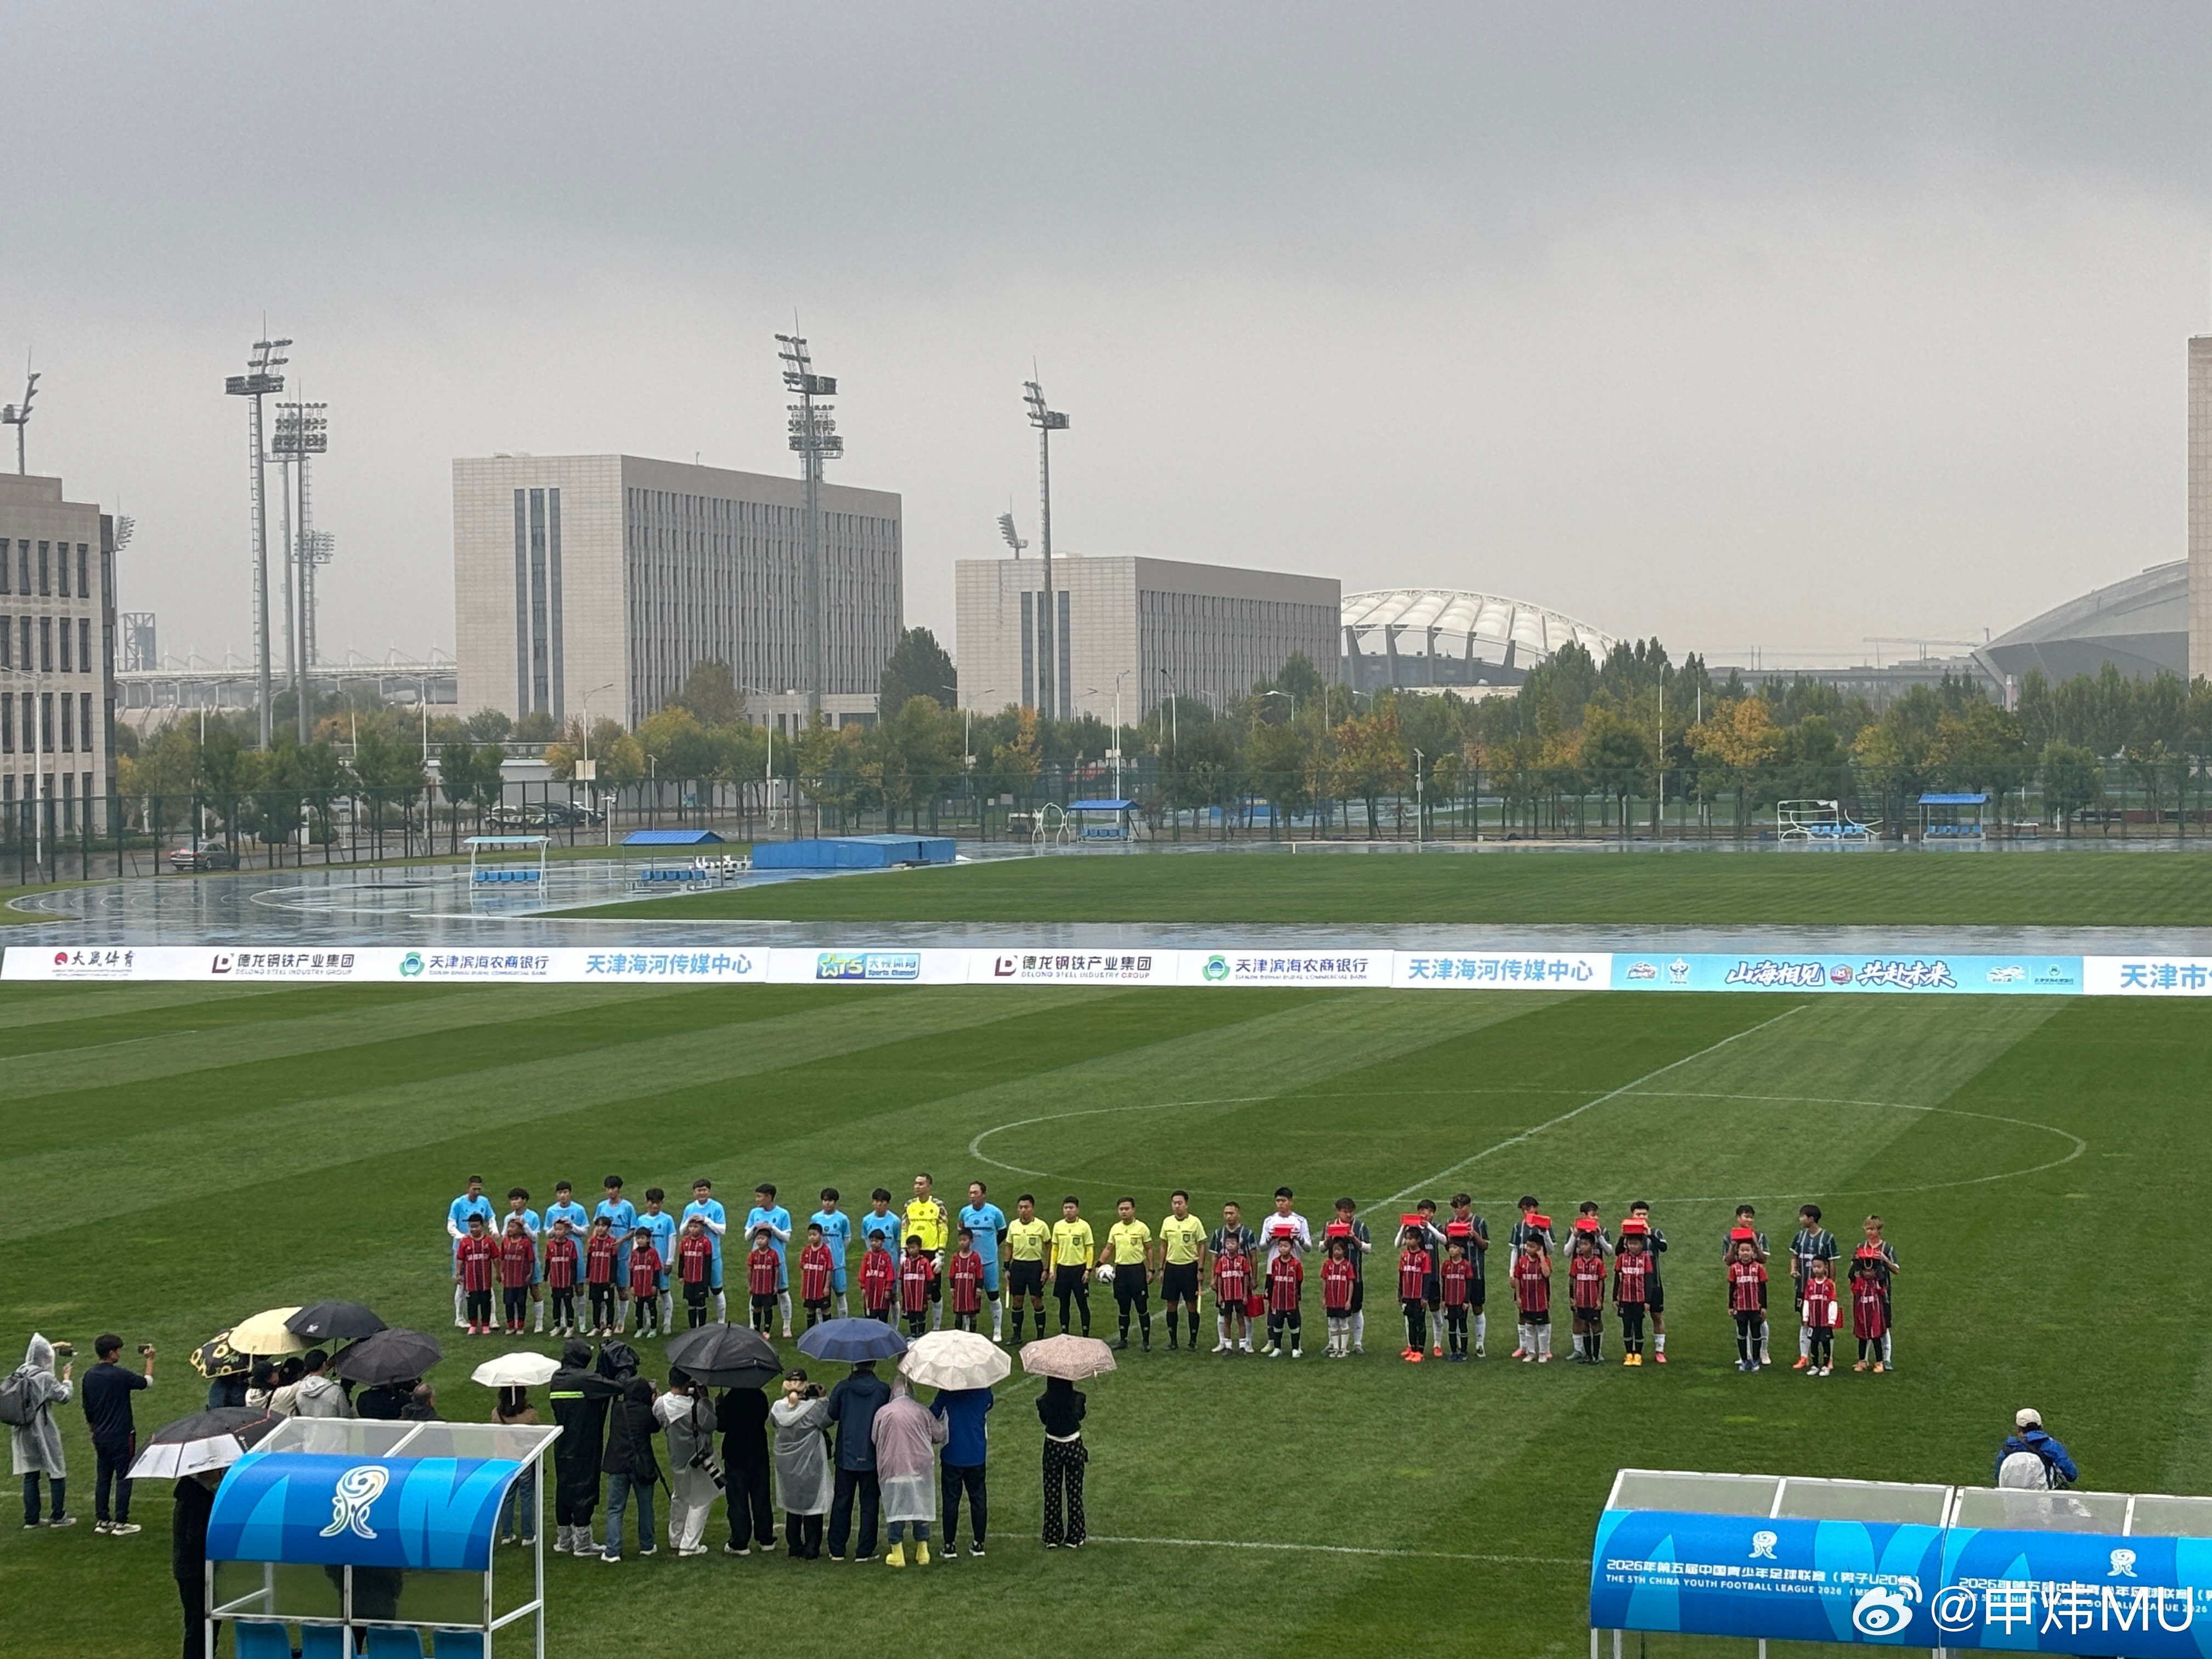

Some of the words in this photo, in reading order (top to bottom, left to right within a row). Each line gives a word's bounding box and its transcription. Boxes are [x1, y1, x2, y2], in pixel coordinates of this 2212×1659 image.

[237, 953, 354, 967] 德龙钢铁产业集团
[430, 955, 549, 969] 天津滨海农商银行
[585, 953, 752, 974] 天津海河传媒中心
[1023, 956, 1152, 970] 德龙钢铁产业集团
[1236, 958, 1369, 973] 天津滨海农商银行
[1408, 958, 1593, 981] 天津海河传媒中心
[1725, 960, 1825, 987] 山海相见
[1856, 960, 1957, 989] 共赴未来
[2120, 963, 2212, 990] 天津市
[1606, 1574, 1624, 1583] THE
[1628, 1575, 1645, 1584] 5TH
[1649, 1576, 1680, 1585] CHINA
[1683, 1578, 1717, 1588] YOUTH
[1720, 1580, 1772, 1592] FOOTBALL
[1775, 1583, 1814, 1594] LEAGUE
[1818, 1586, 1842, 1595] 2026
[2182, 1604, 2208, 1613] 226
